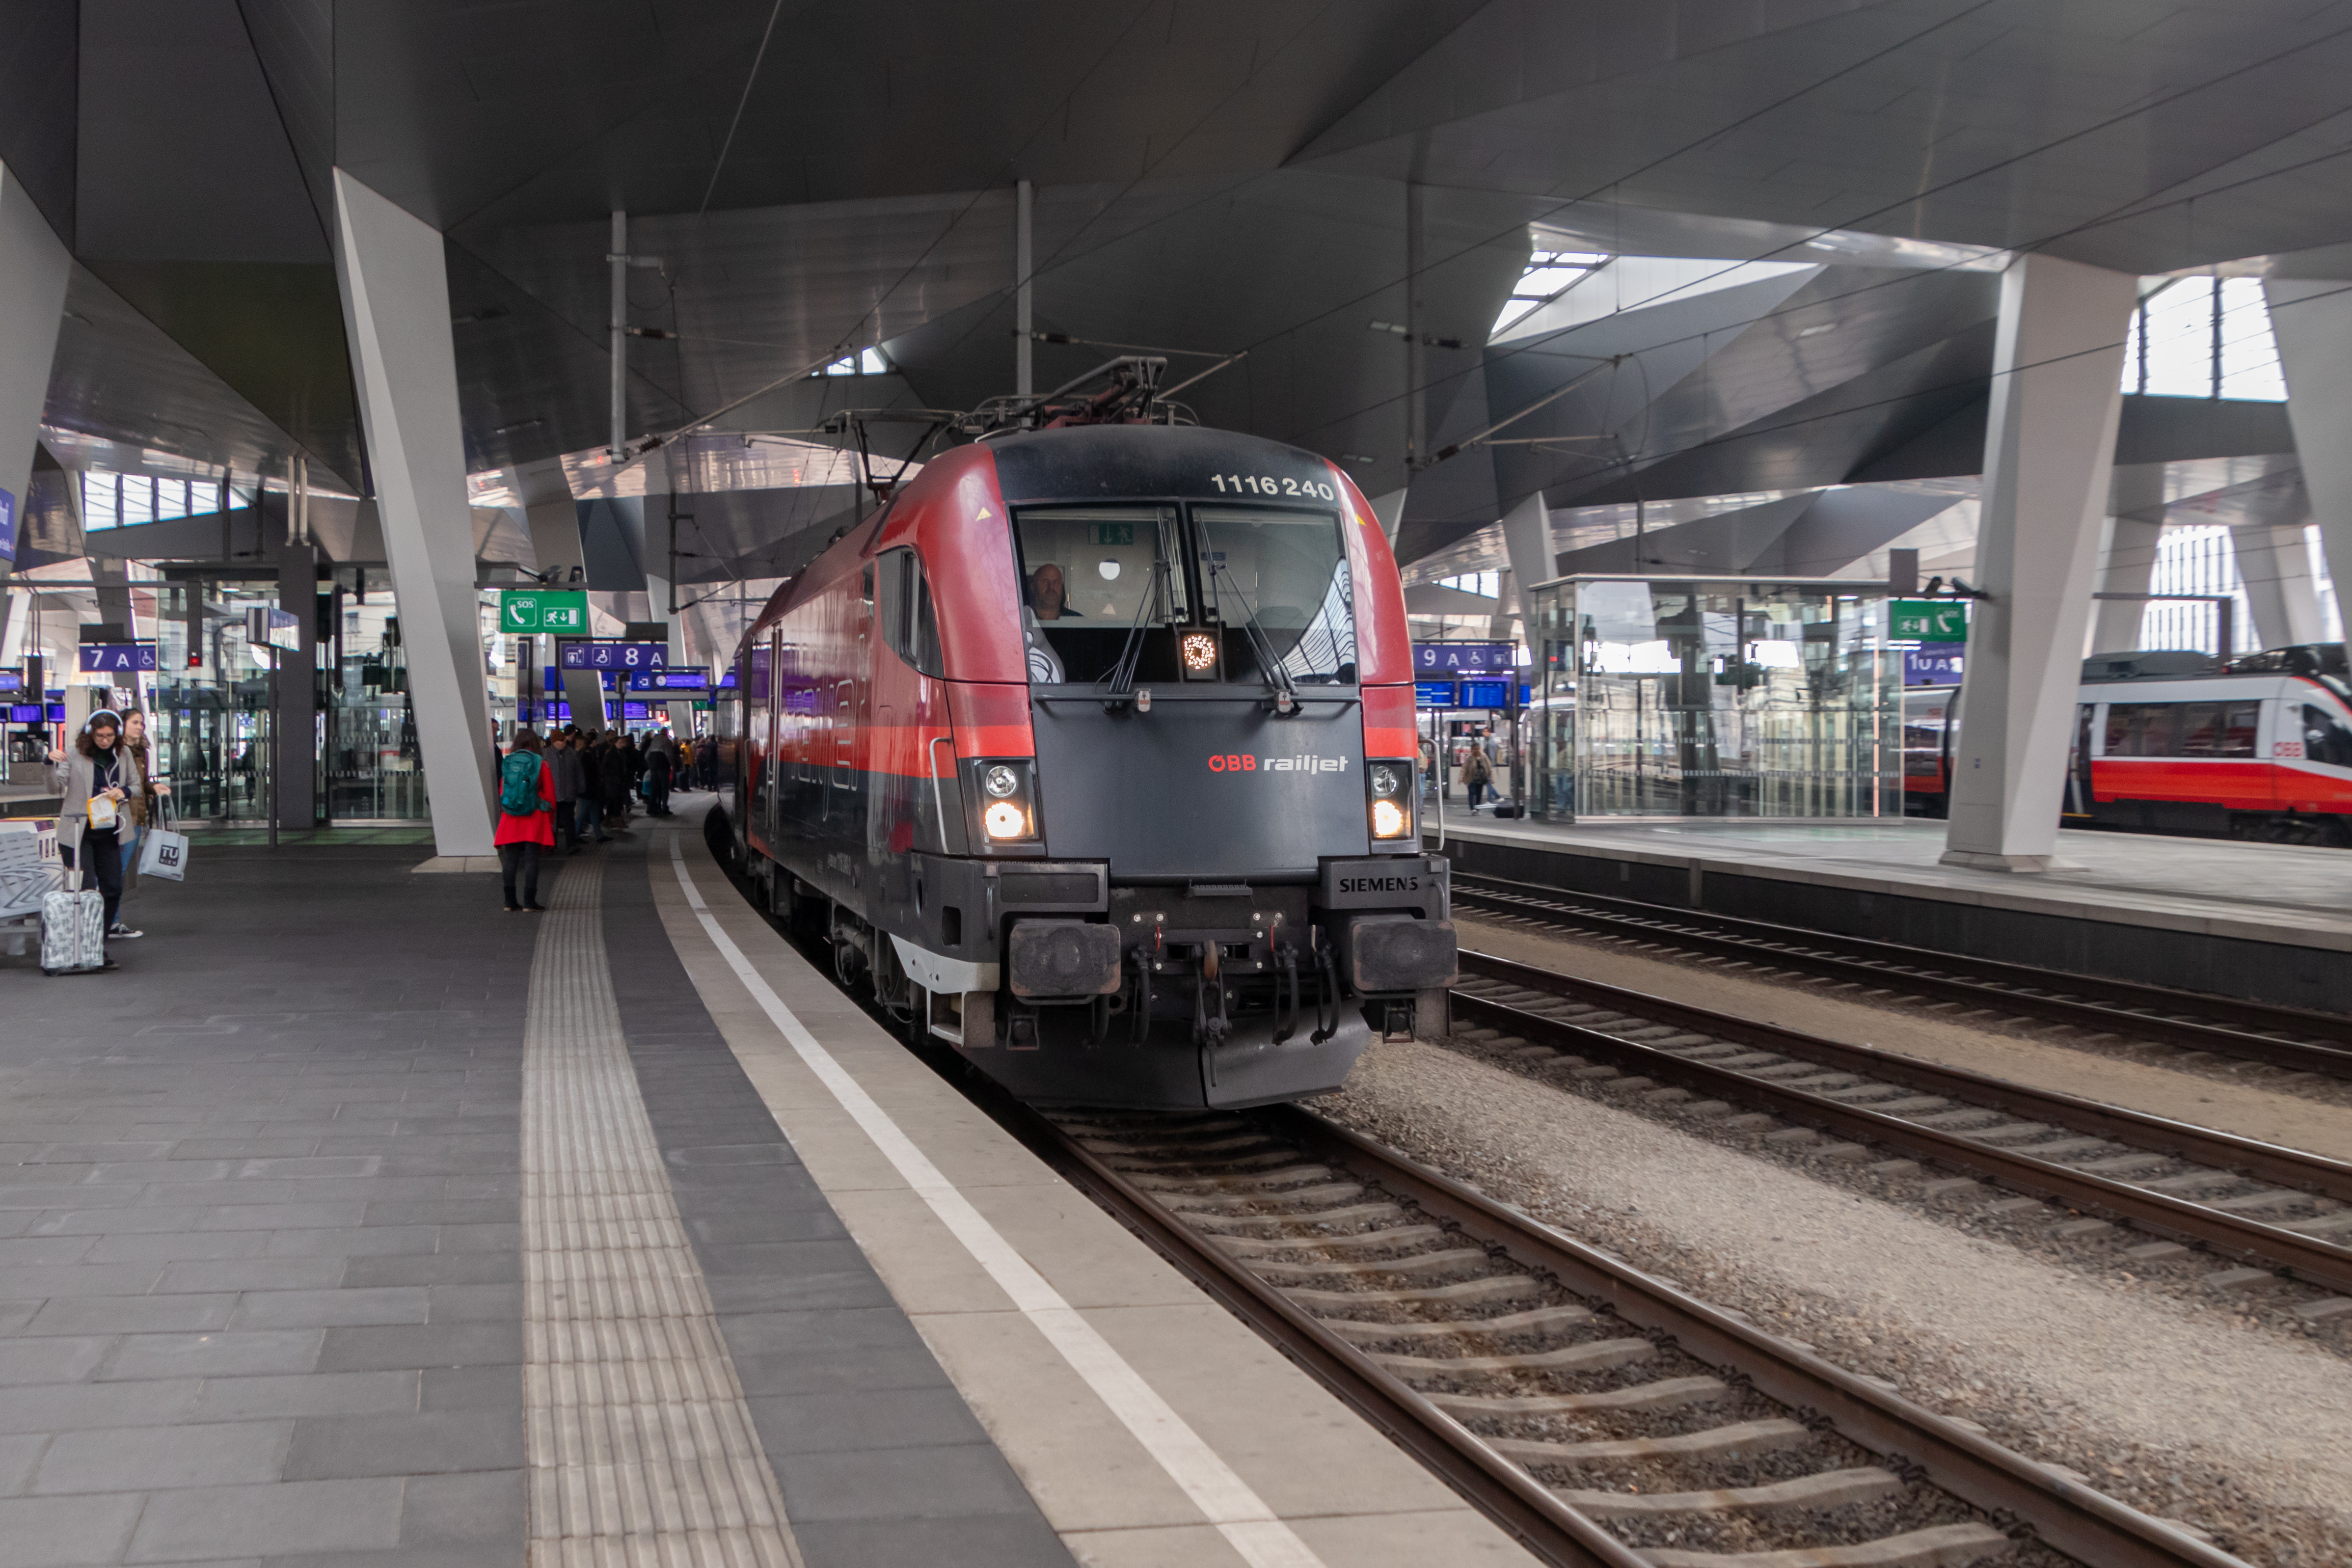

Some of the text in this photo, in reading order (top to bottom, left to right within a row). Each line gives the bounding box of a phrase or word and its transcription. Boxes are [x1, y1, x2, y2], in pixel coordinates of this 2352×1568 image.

[1211, 474, 1334, 501] 1116 240
[516, 600, 534, 609] SOS
[90, 649, 130, 668] 7 A
[625, 648, 663, 666] 8 A
[1424, 649, 1460, 666] 9 A
[1935, 659, 1949, 670] A
[1208, 755, 1349, 775] ÖBB railjet
[162, 846, 178, 859] TU
[1339, 877, 1418, 892] SIEMENS
